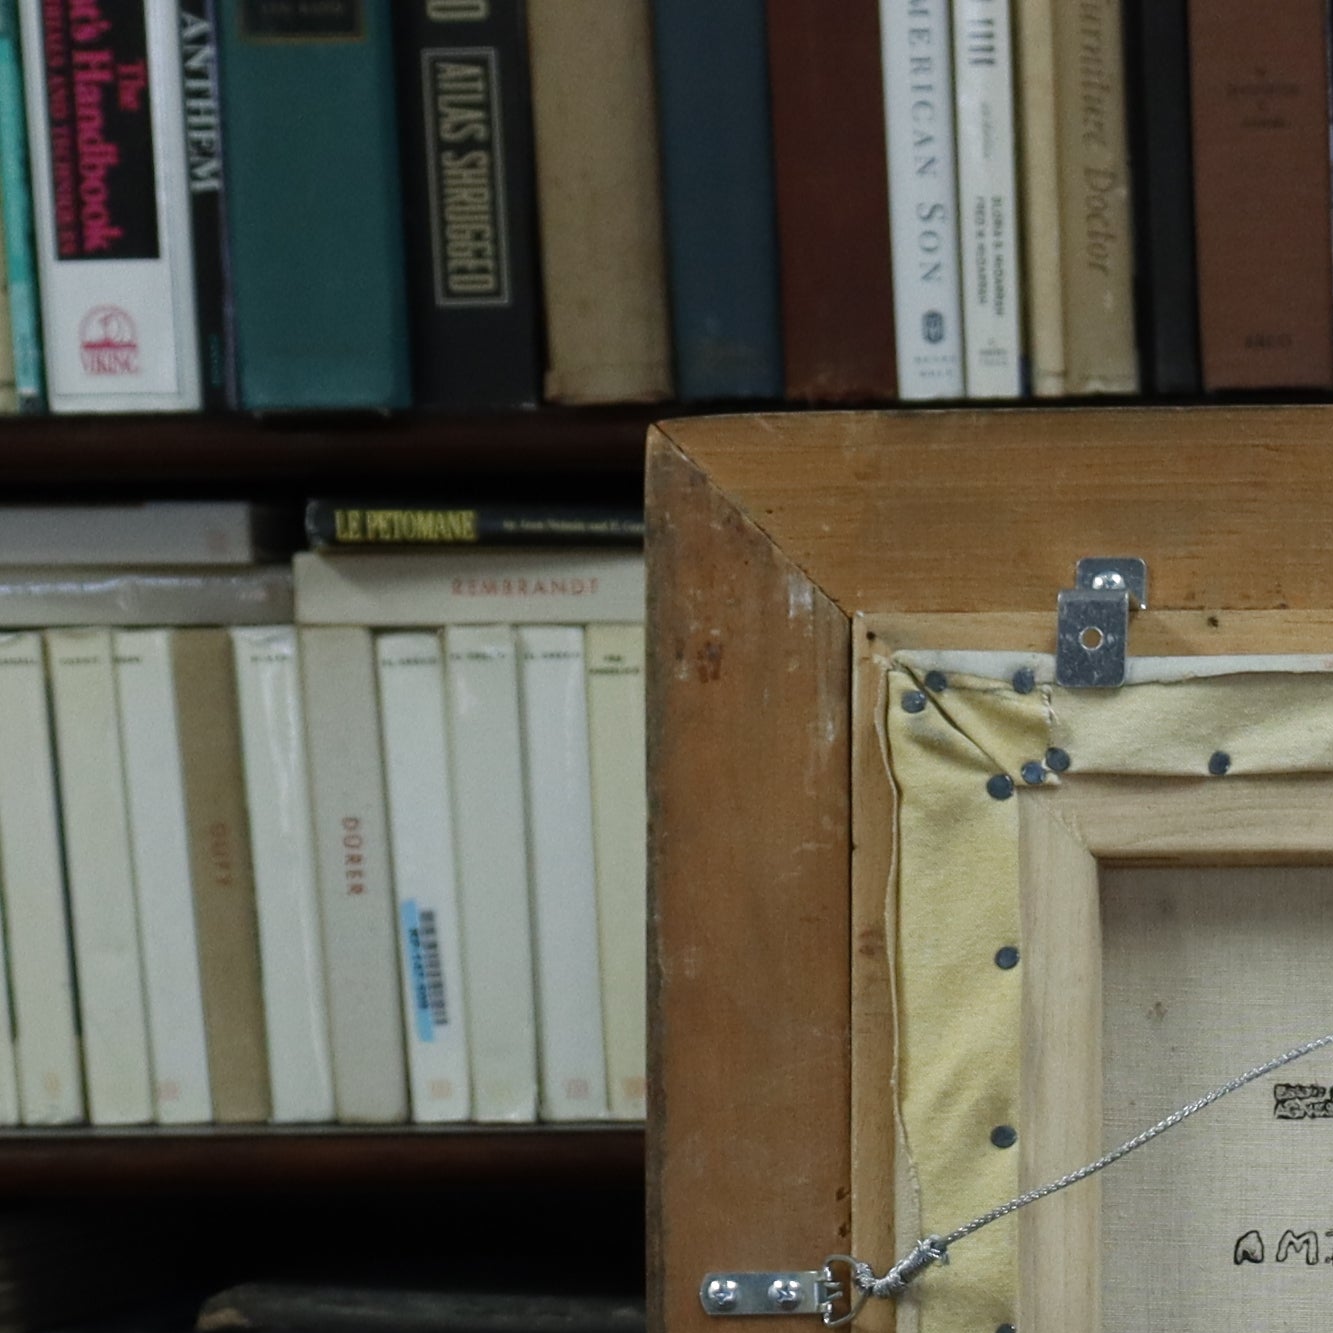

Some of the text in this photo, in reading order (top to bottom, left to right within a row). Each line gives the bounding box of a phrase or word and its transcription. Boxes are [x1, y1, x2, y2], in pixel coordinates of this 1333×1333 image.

[180, 11, 223, 193] ANTHEM
[434, 62, 487, 141] ATLAS
[70, 50, 123, 252] Handbook
[439, 149, 494, 293] SHRUGGED
[918, 202, 946, 284] SON
[335, 509, 477, 541] LE PETOMANE
[451, 578, 599, 596] REMBRANDT
